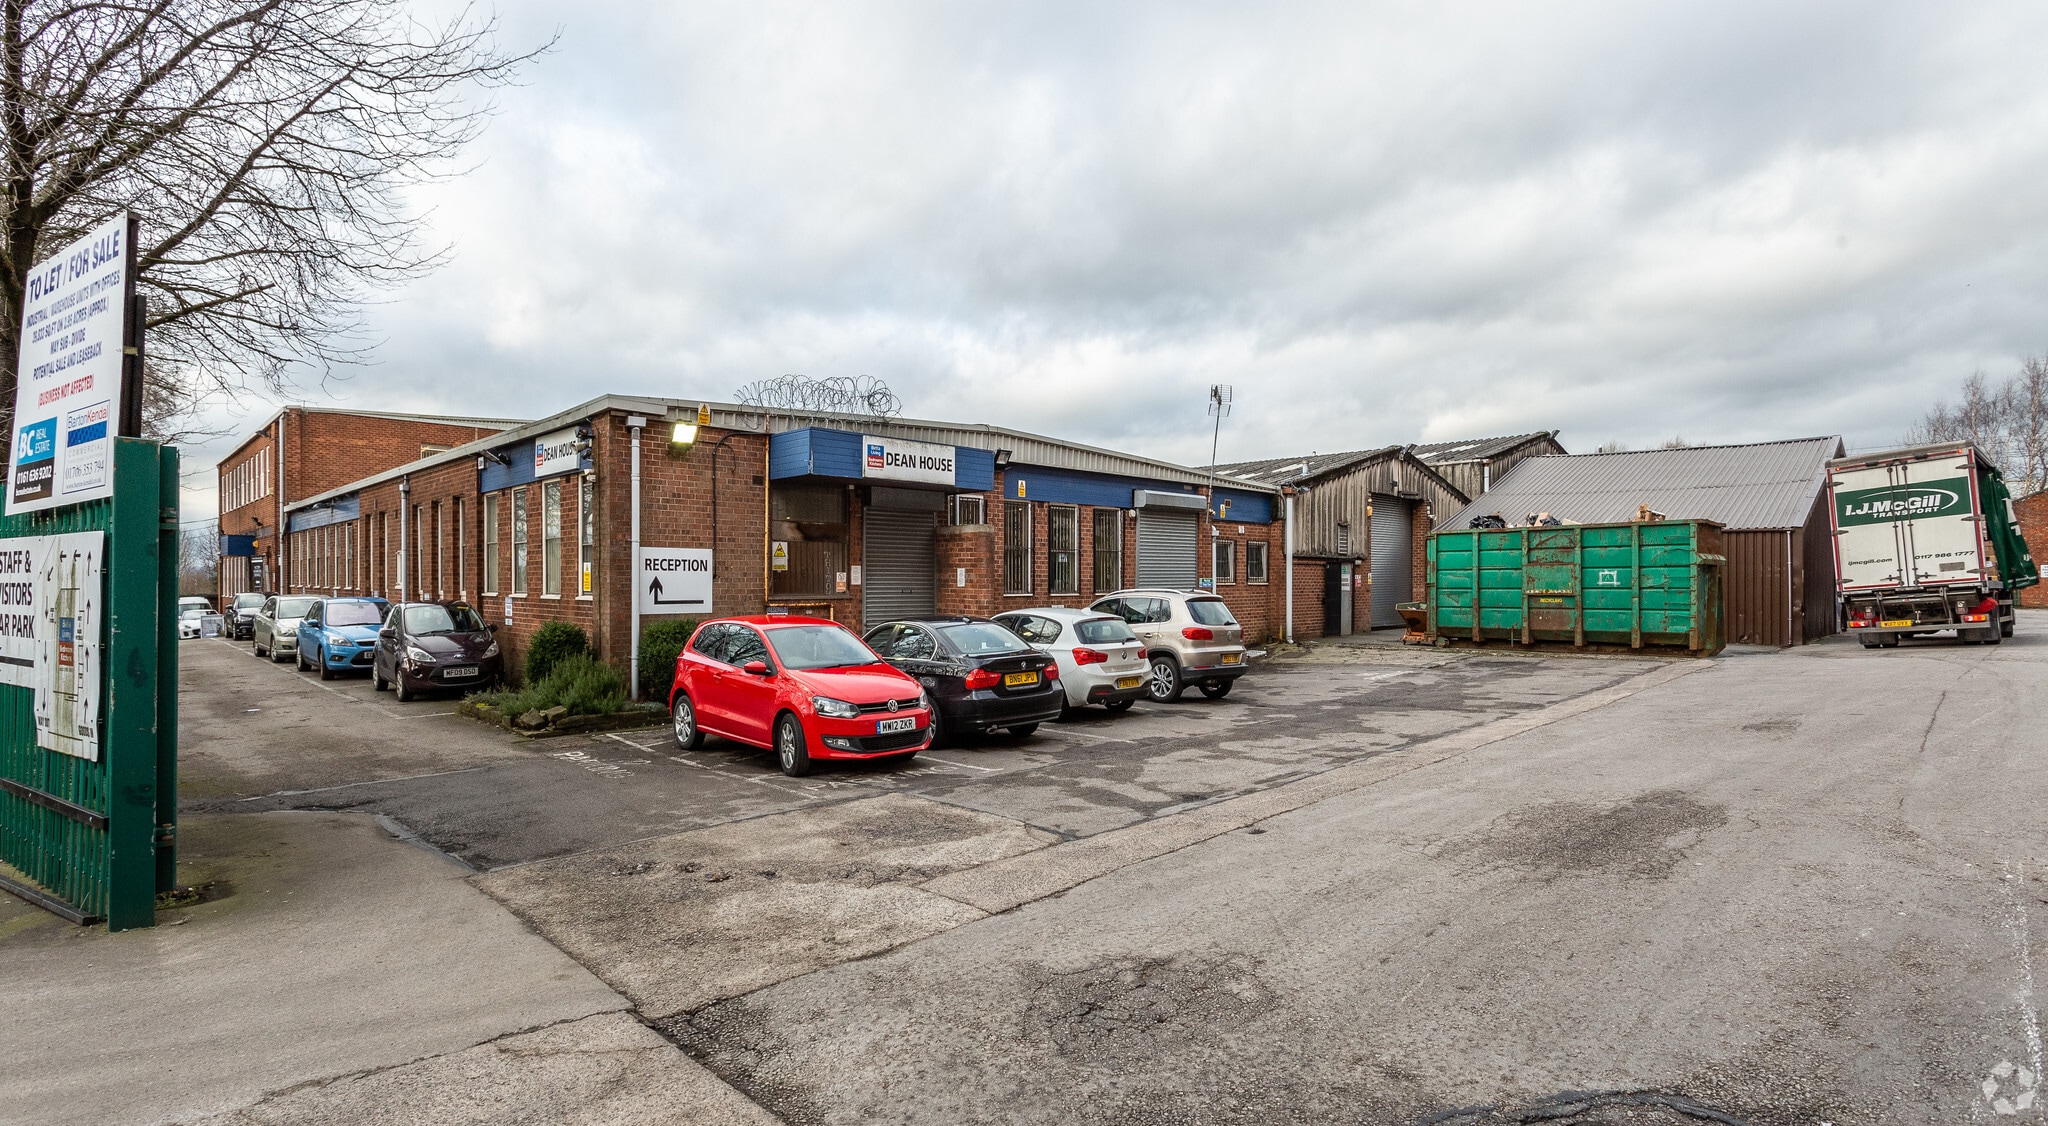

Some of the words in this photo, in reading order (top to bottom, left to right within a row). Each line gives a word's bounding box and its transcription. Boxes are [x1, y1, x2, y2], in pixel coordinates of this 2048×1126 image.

[29, 274, 43, 304] TO
[43, 263, 63, 296] LET
[69, 247, 90, 282] FOR
[92, 228, 121, 270] SALE
[76, 285, 90, 305] UNITS
[89, 279, 101, 298] WITH
[101, 268, 121, 292] OFFICES
[73, 306, 88, 326] ACRES
[50, 340, 60, 355] MAY
[59, 335, 69, 352] SUB
[71, 327, 86, 347] DIVIDE
[33, 360, 56, 381] POTENTIAL
[55, 355, 67, 373] SALE
[66, 352, 77, 369] AND
[76, 340, 103, 365] LEASEBACK
[38, 386, 61, 409] (BUSINESS
[60, 382, 71, 399] NOT
[70, 374, 95, 396] AFFECTED)
[18, 429, 36, 459] BC
[35, 427, 48, 440] REAL
[34, 439, 51, 455] ESTATE
[543, 445, 559, 462] DEAN
[558, 440, 576, 459] HOUS
[885, 451, 917, 469] DEAN
[918, 455, 953, 472] HOUSE
[16, 469, 30, 485] 0161
[38, 464, 53, 481] 9202
[1872, 506, 1940, 519] TRANSPORT
[24, 549, 32, 574] &
[644, 557, 708, 572] RECEPTION
[1847, 557, 1893, 567] ijmcgill.com
[1934, 551, 1952, 559] 986
[11, 614, 35, 640] PARK
[899, 718, 913, 730] ZKR
